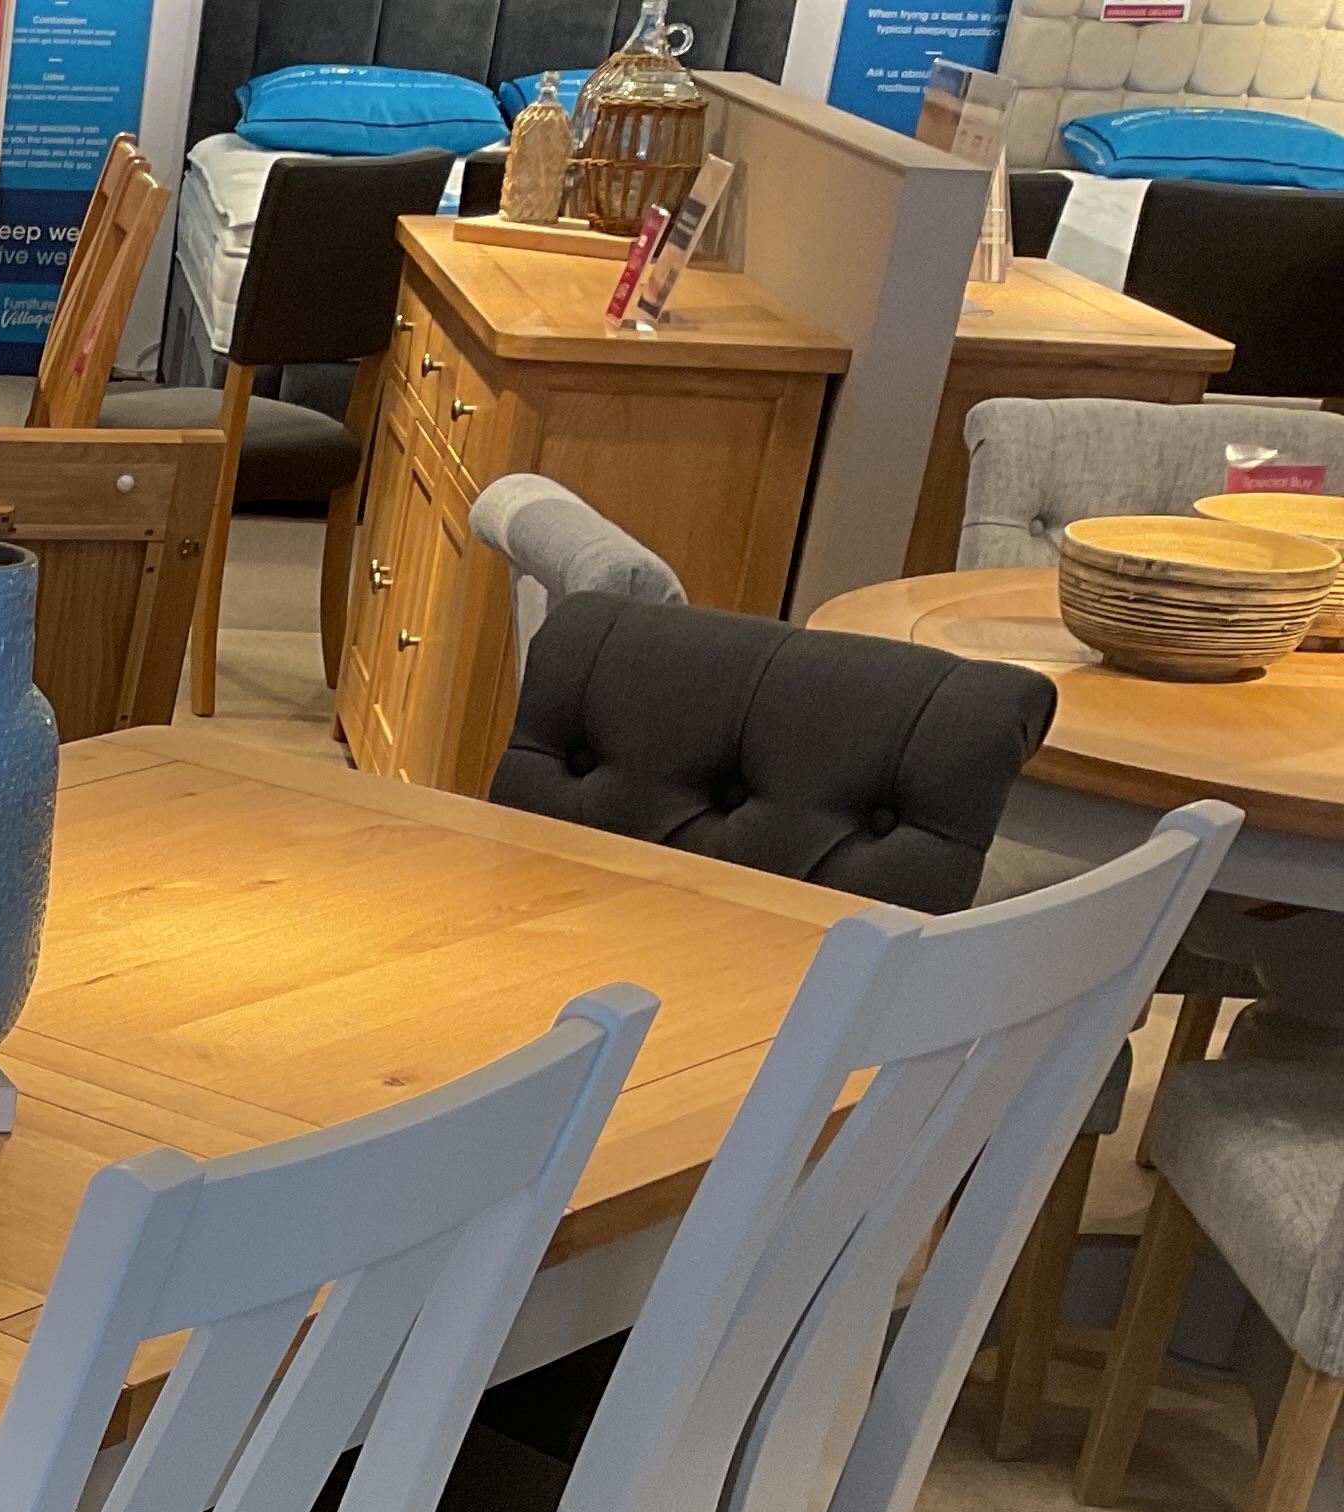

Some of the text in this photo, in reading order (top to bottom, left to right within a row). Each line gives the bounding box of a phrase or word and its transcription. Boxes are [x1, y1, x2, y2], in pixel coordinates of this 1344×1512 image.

[868, 8, 898, 19] When
[900, 10, 929, 22] trying
[931, 12, 940, 21] a
[981, 12, 991, 21] in
[876, 24, 912, 36] typical
[914, 26, 958, 38] sleeping
[866, 68, 931, 79] Ask us abou
[877, 84, 920, 94] mattress
[49, 225, 80, 242] we
